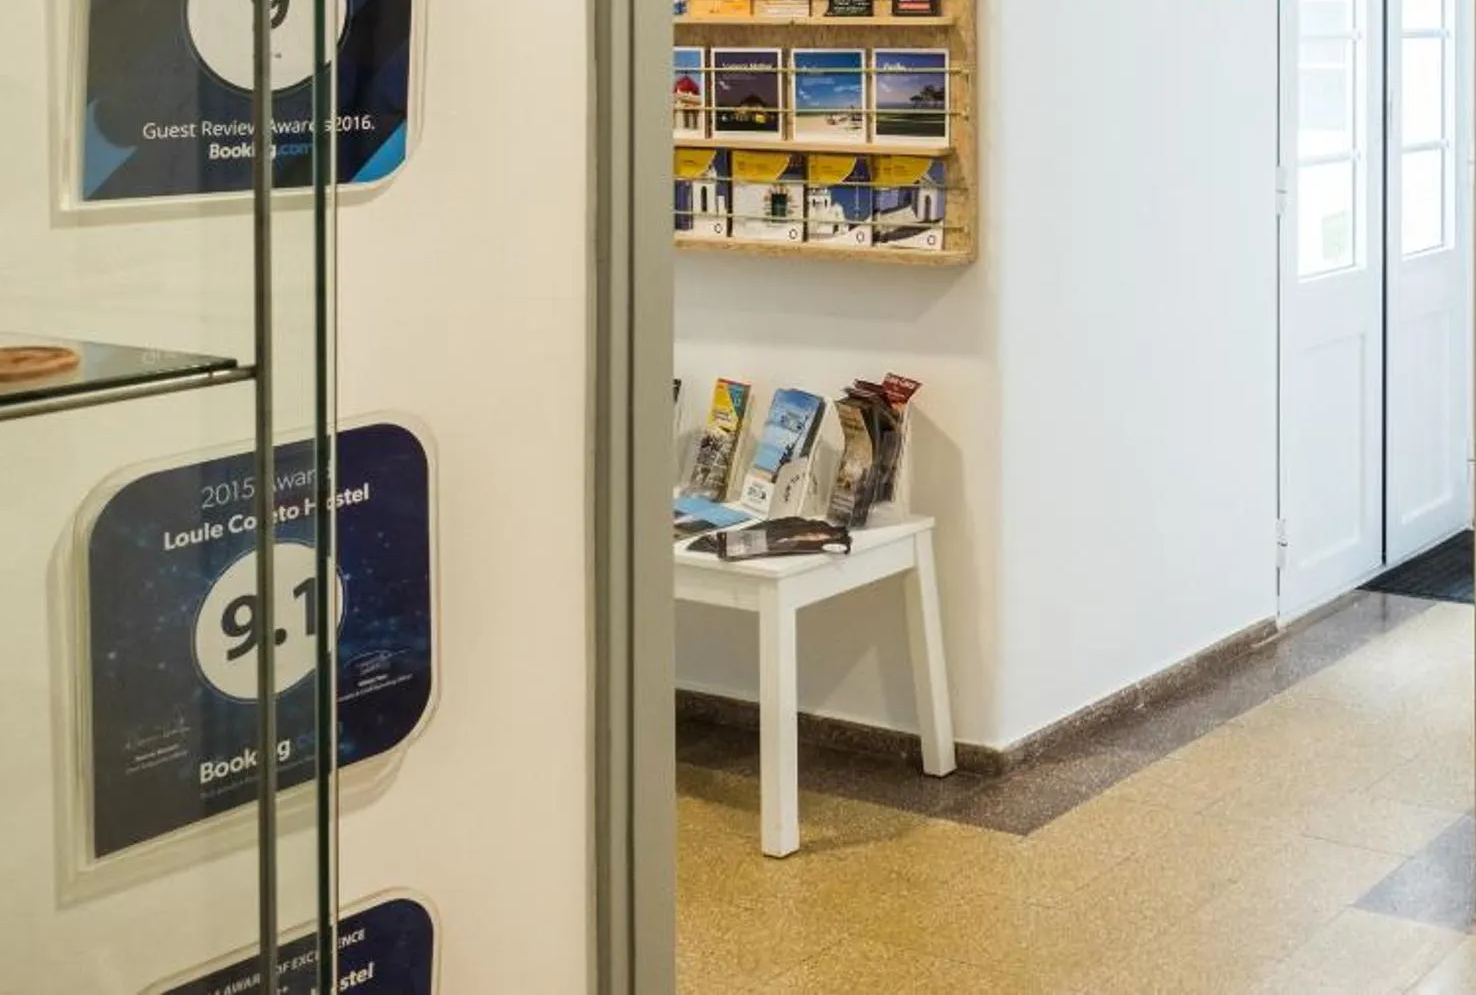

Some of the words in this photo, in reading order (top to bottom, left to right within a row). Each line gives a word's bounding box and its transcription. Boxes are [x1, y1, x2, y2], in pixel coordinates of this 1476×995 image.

[142, 122, 197, 140] Guest
[200, 476, 257, 510] 2015
[163, 521, 224, 551] Loule
[228, 505, 300, 535] Coto
[220, 577, 317, 662] 9.1
